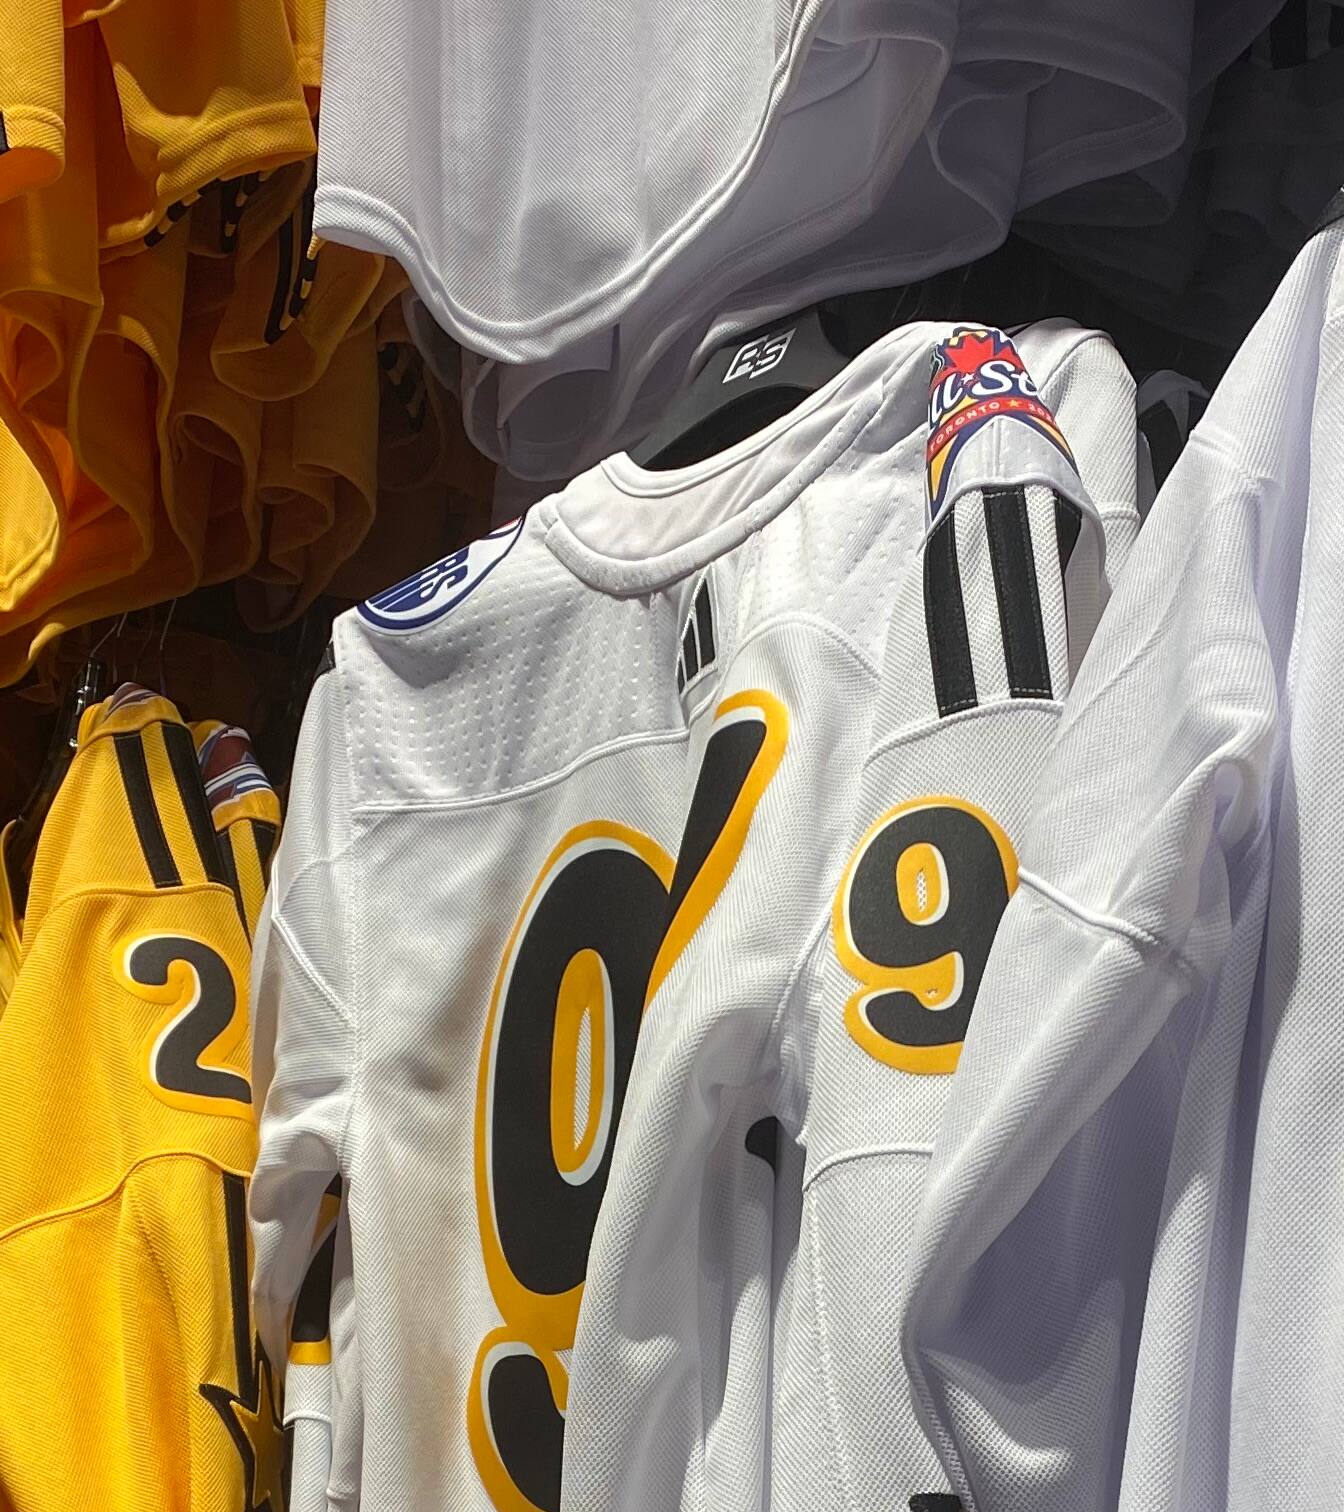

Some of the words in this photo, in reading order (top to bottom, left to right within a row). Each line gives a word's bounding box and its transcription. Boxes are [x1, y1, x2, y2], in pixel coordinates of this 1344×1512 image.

[970, 359, 1039, 397] St
[1027, 404, 1057, 424] 202
[113, 930, 253, 1117] 2
